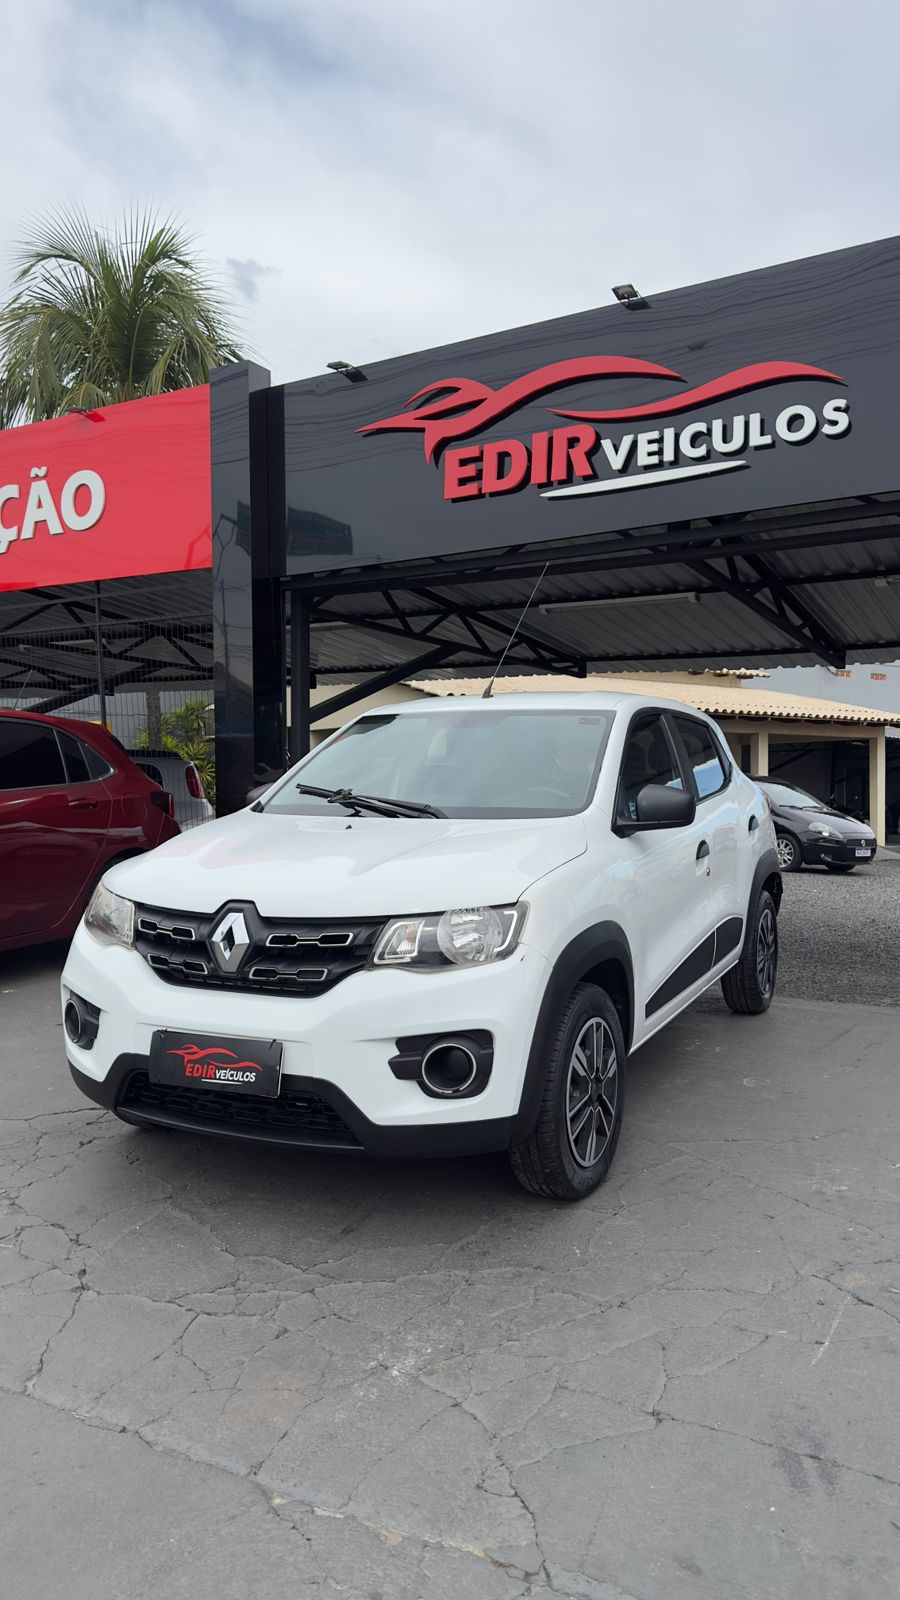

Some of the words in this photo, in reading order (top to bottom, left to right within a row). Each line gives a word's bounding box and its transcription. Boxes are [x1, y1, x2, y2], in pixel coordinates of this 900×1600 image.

[443, 425, 597, 500] EDIR
[601, 398, 850, 470] VEICULOS
[185, 1063, 216, 1079] EDIR
